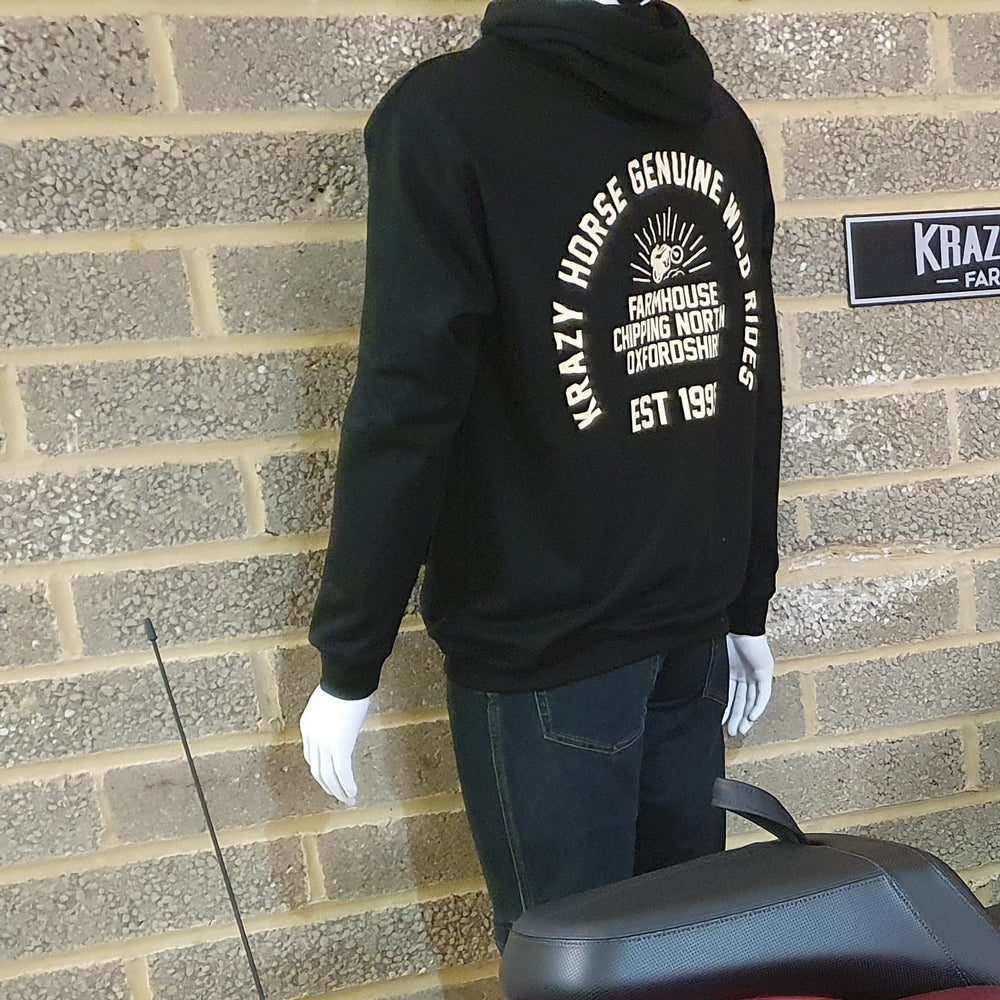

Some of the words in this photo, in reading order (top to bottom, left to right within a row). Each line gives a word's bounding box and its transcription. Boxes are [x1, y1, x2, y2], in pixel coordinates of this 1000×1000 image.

[627, 151, 724, 205] GENUINE
[558, 176, 628, 289] HORSE
[722, 192, 751, 279] WILD
[628, 281, 718, 321] FARMHOUSE
[613, 315, 671, 352] CHIPPING
[626, 333, 719, 375] OXFORDSHIR
[738, 289, 759, 391] RIDES
[553, 301, 602, 430] KRAZY
[630, 391, 668, 433] EST
